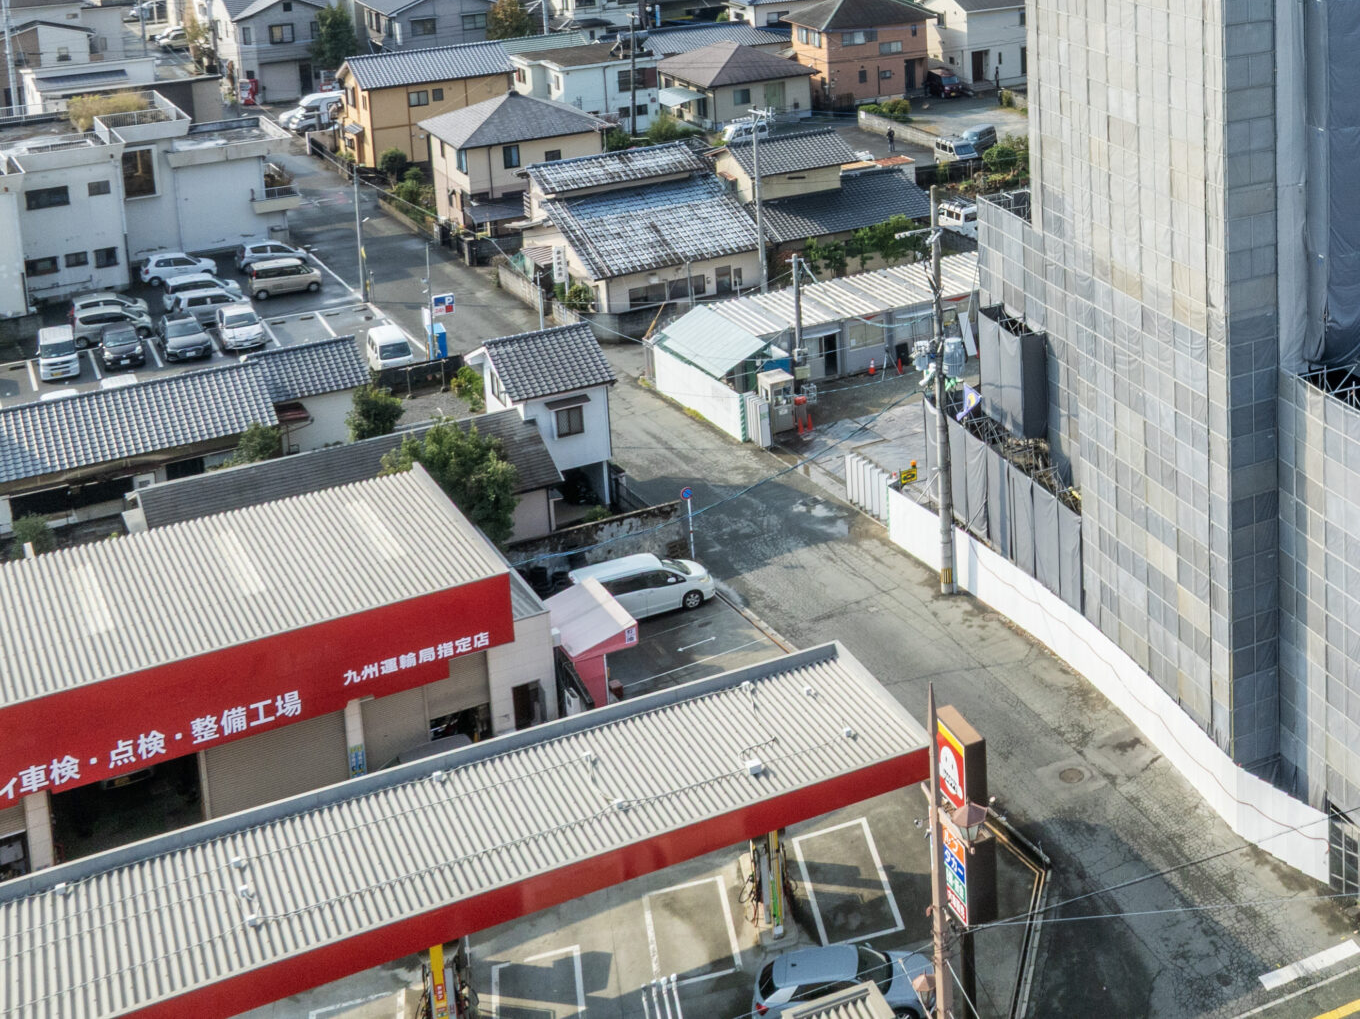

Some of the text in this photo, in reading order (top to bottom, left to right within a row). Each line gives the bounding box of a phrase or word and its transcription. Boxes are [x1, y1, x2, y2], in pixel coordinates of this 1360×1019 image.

[445, 296, 453, 305] P
[343, 631, 490, 686] 九州運輸局指定店
